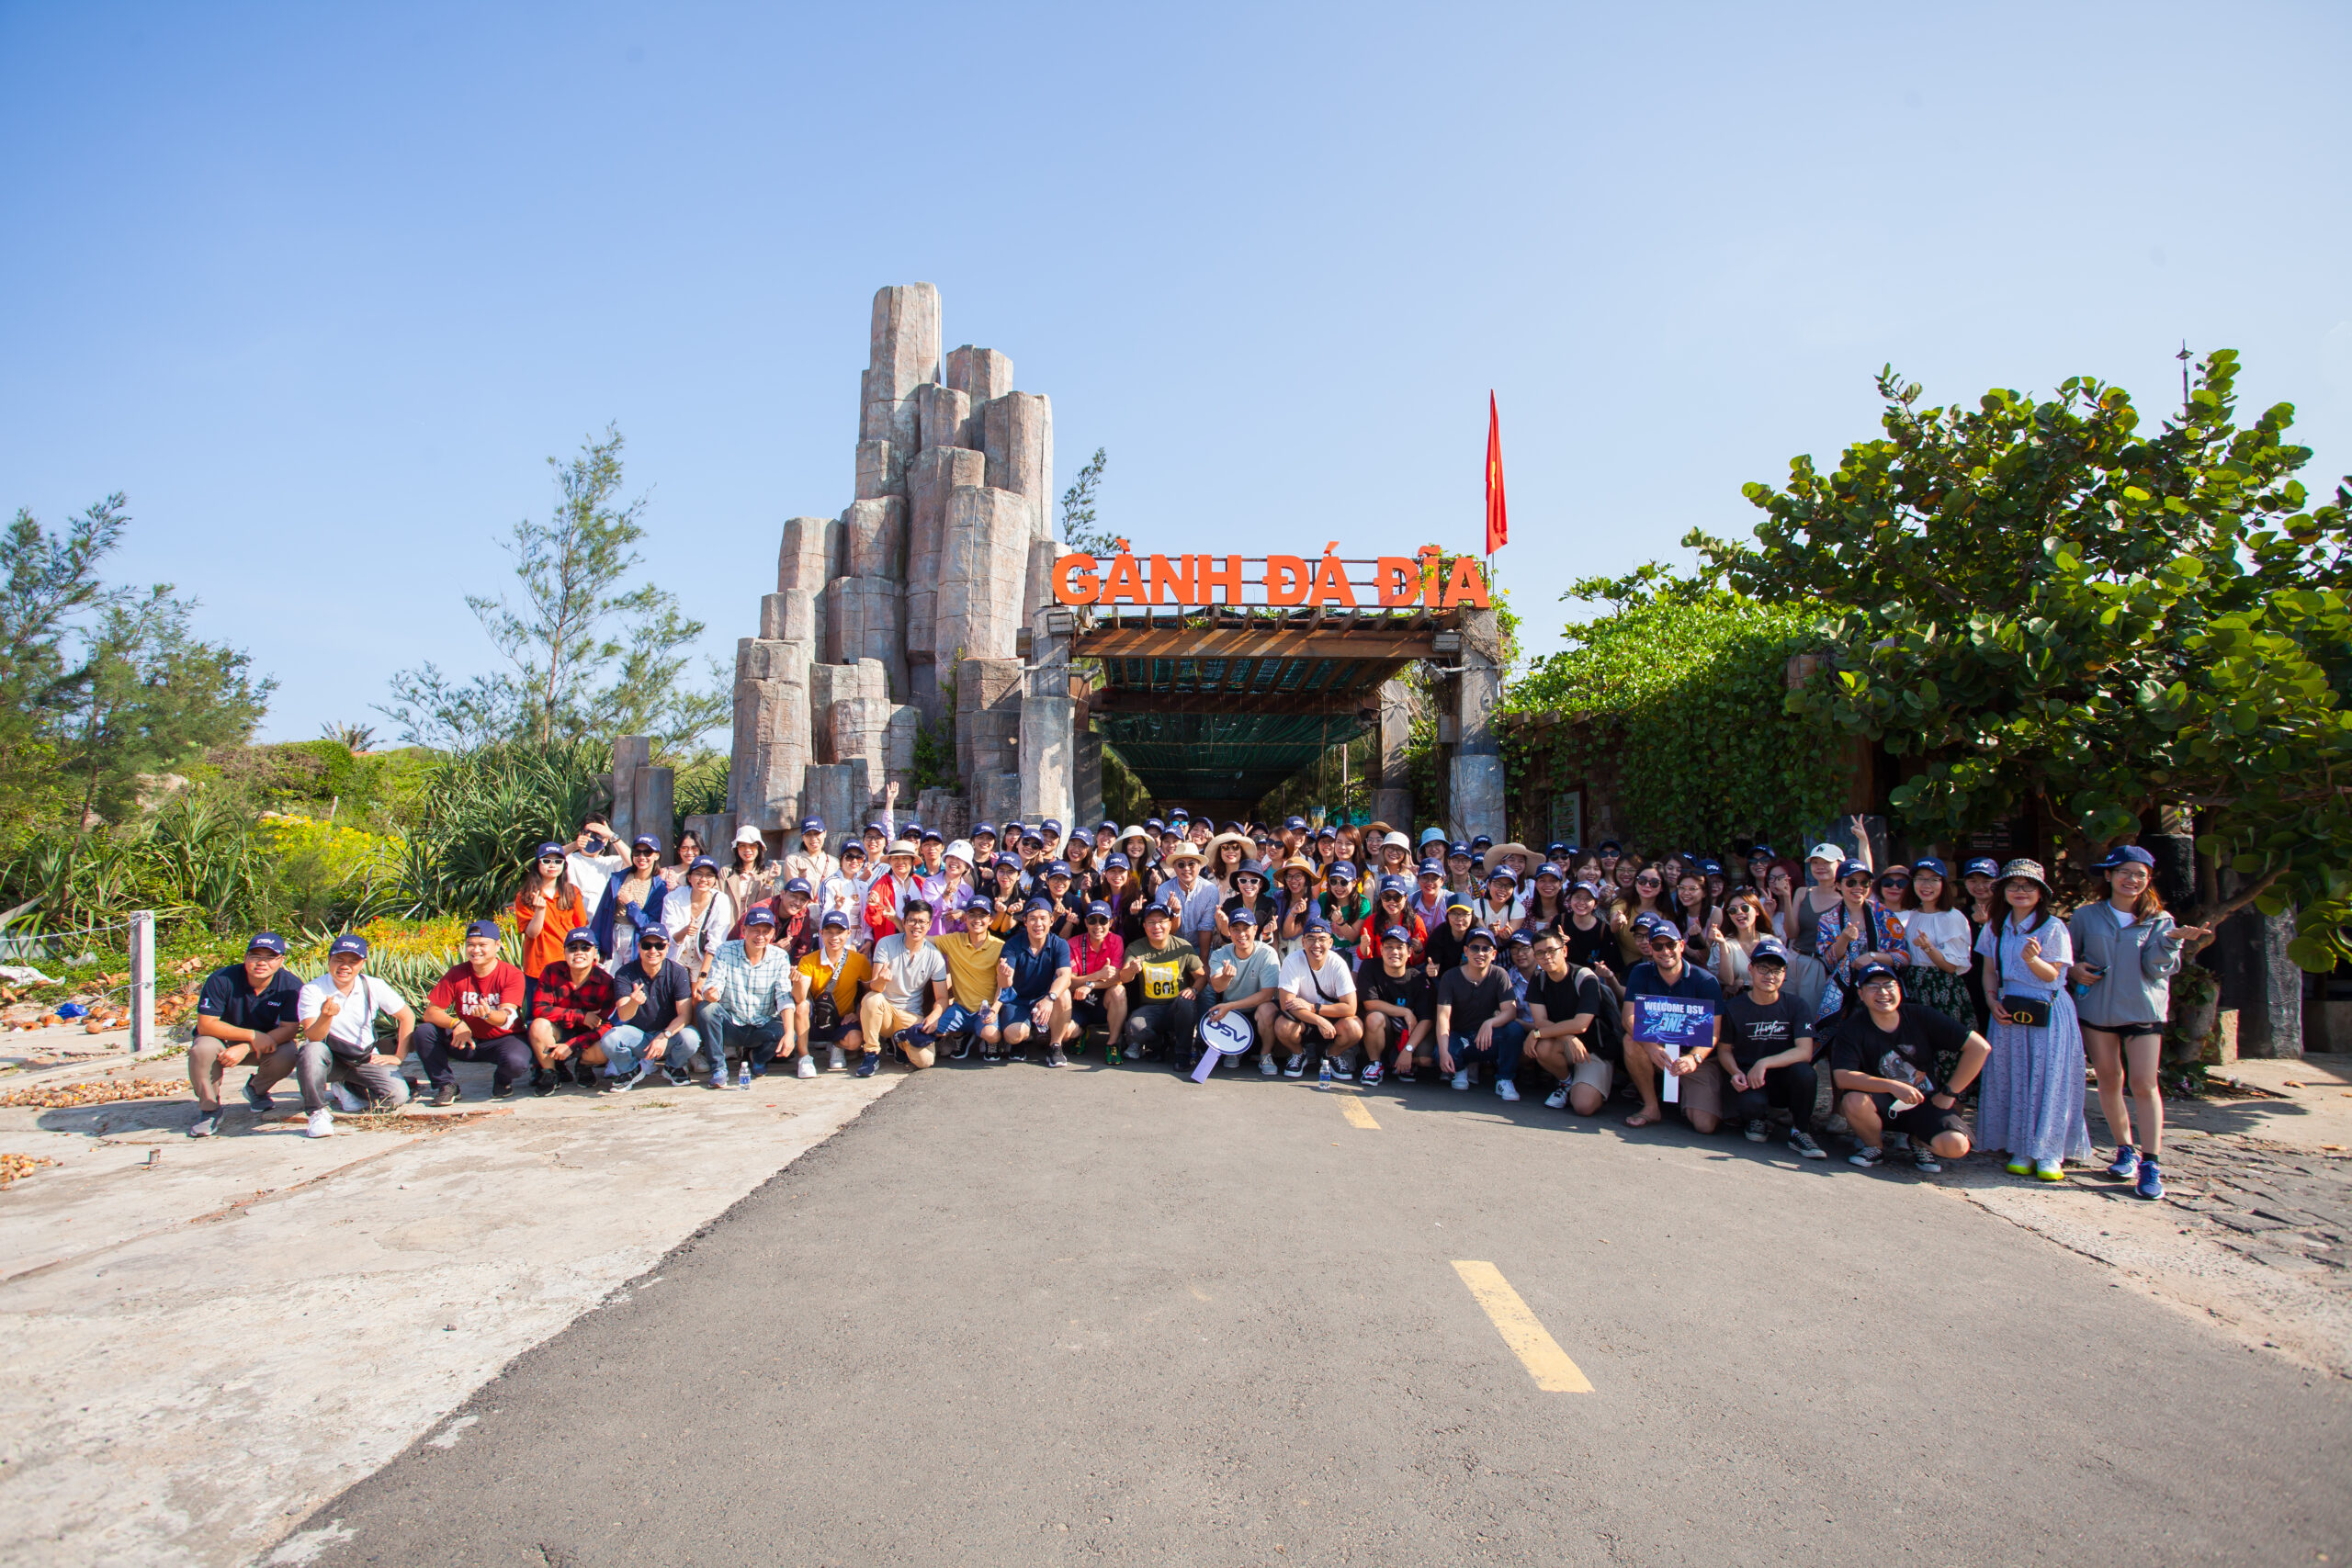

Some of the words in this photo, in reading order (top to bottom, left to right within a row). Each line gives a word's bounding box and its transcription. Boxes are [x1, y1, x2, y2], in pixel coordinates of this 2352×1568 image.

[1052, 538, 1242, 605] GÀNH
[1262, 541, 1357, 607] ĐÁ
[1374, 545, 1491, 608] ĐĨA
[1154, 982, 1174, 996] GO!
[462, 991, 500, 1005] IRN
[1644, 1001, 1684, 1013] WELCOME
[1686, 1004, 1704, 1015] DSV
[1206, 1020, 1248, 1043] DSV
